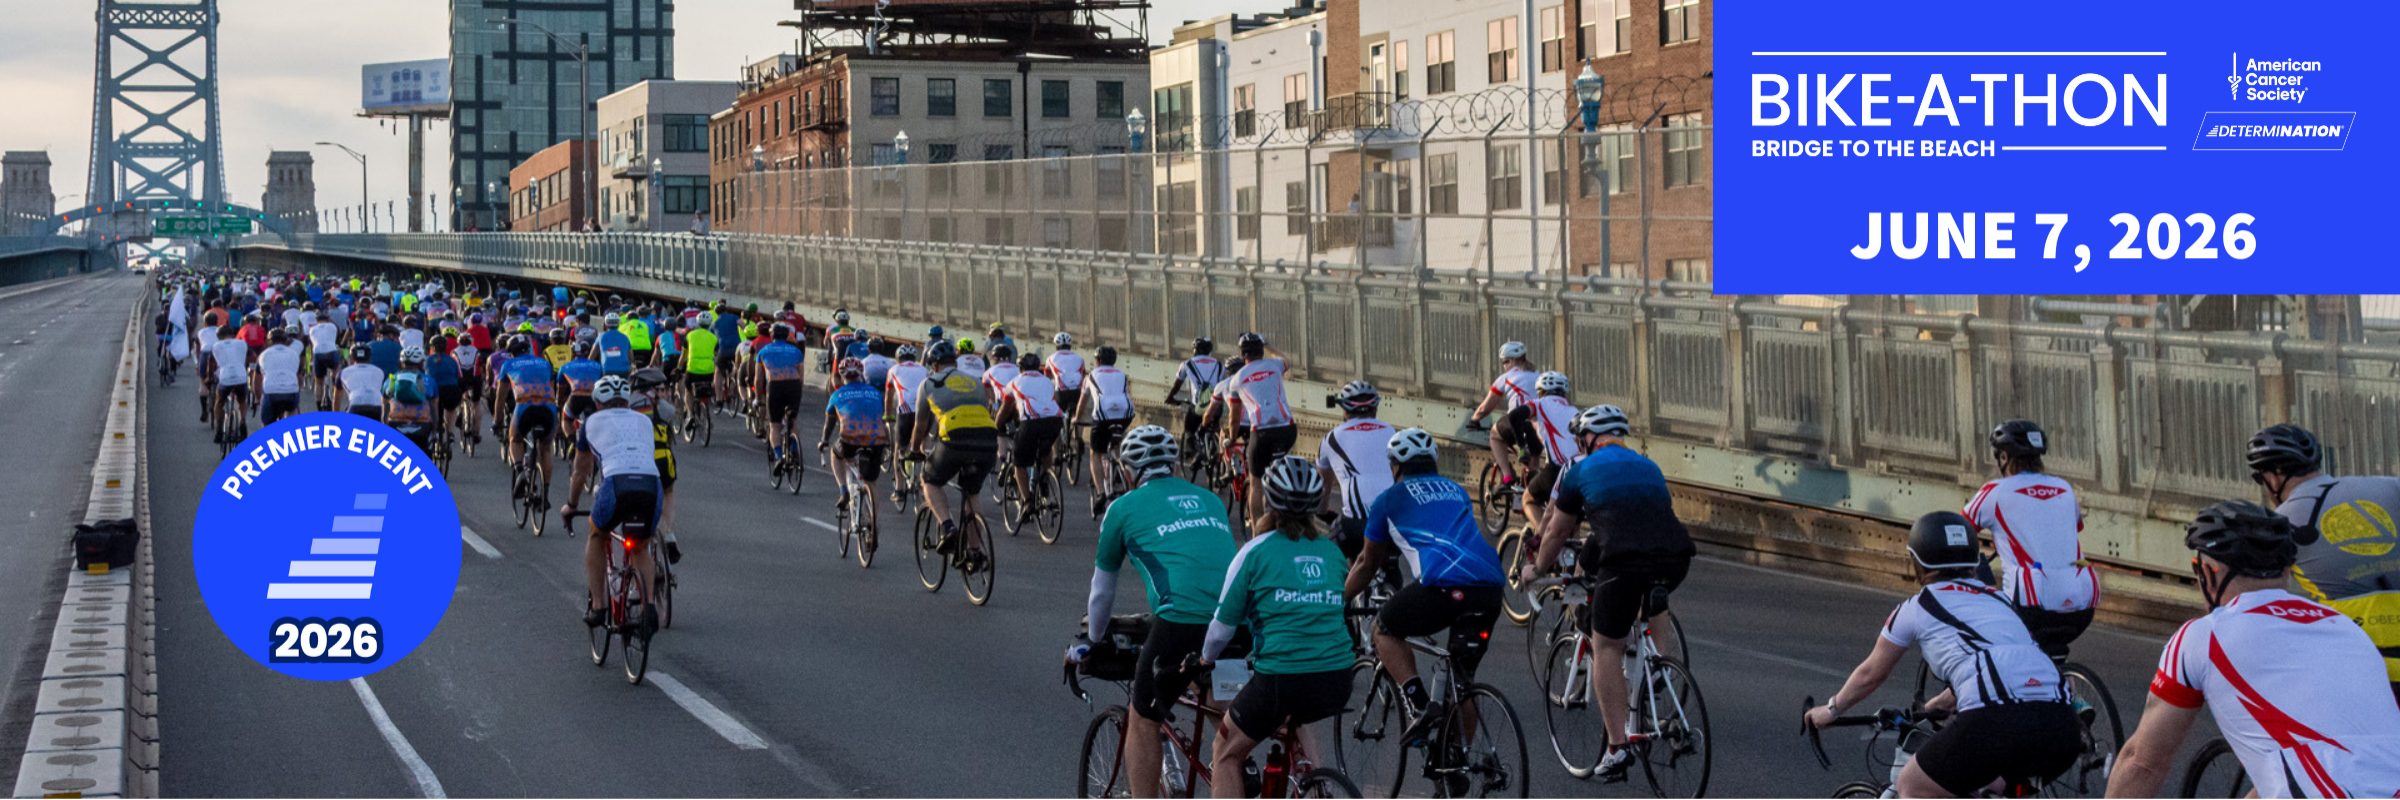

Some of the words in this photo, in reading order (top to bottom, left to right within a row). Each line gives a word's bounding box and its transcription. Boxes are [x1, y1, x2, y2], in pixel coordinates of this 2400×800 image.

[1178, 499, 1200, 510] 40
[1157, 517, 1209, 537] Patient
[1302, 562, 1321, 578] 40
[1275, 589, 1323, 604] Patient
